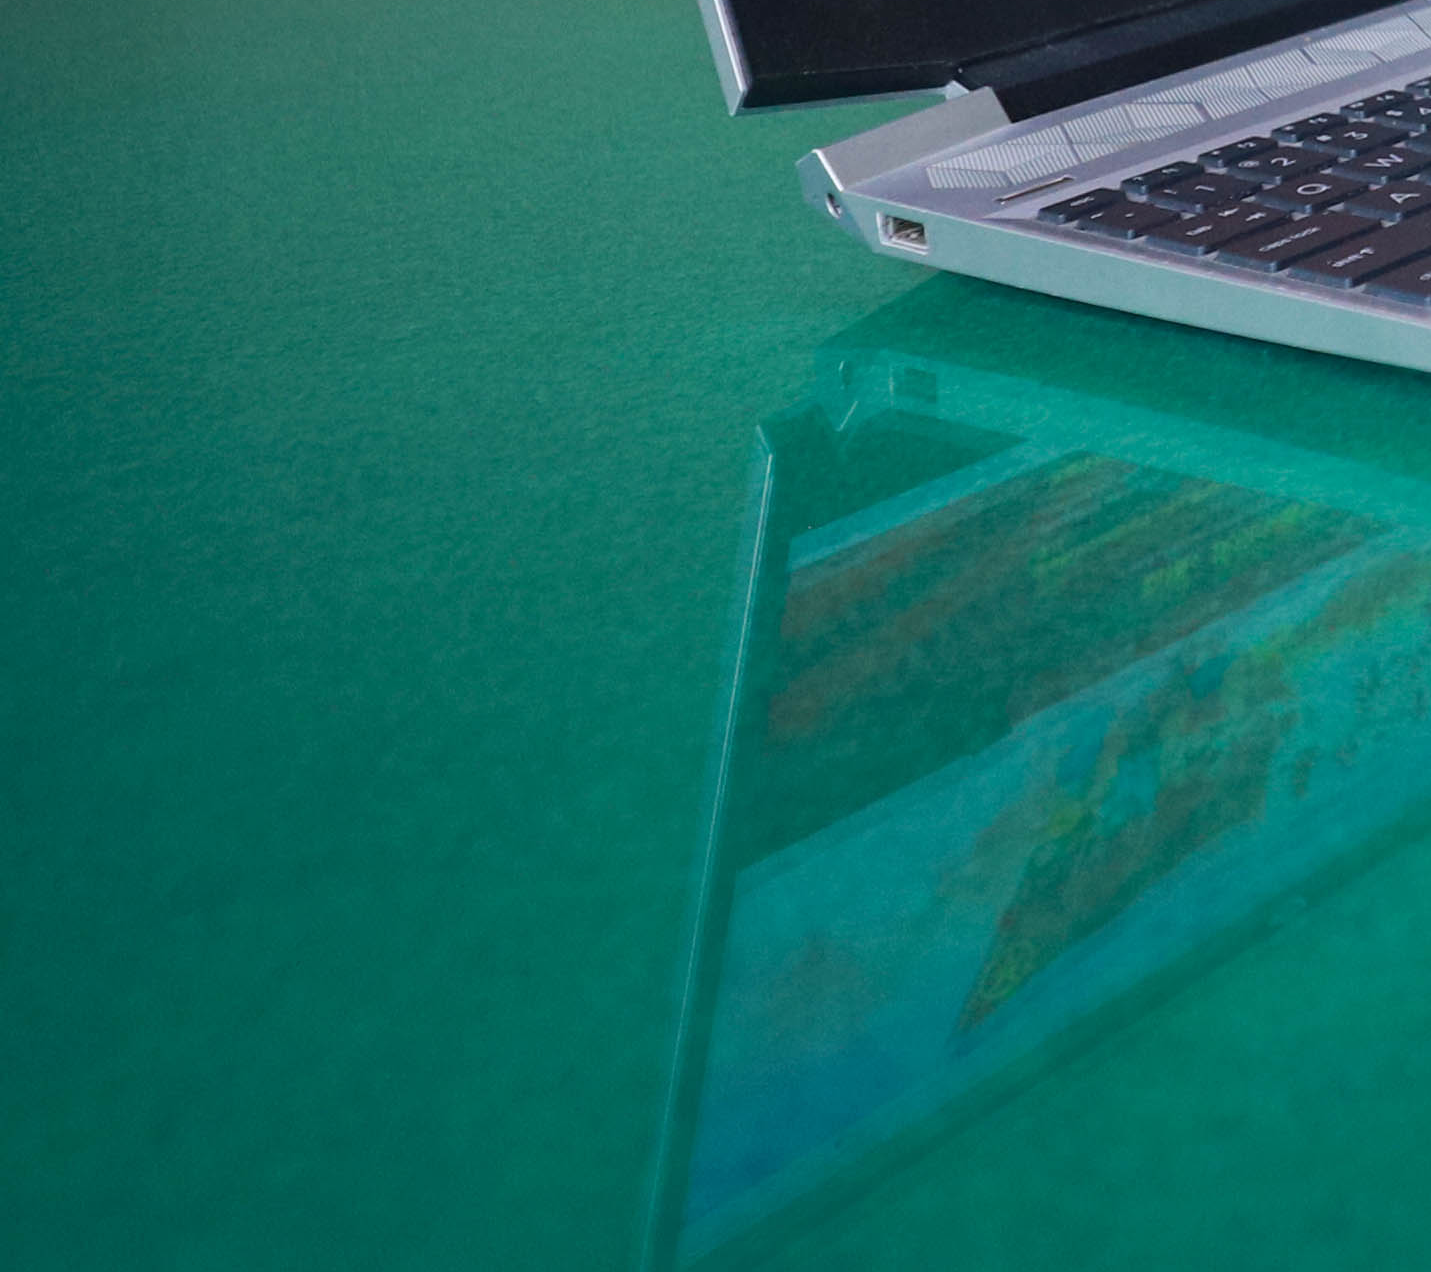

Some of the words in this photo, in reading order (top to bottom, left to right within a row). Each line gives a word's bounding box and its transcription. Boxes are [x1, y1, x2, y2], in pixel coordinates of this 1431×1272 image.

[1343, 131, 1369, 140] 3
[1270, 157, 1298, 167] 2
[1364, 154, 1404, 168] W
[1296, 182, 1333, 196] Q
[1389, 191, 1422, 204] A
